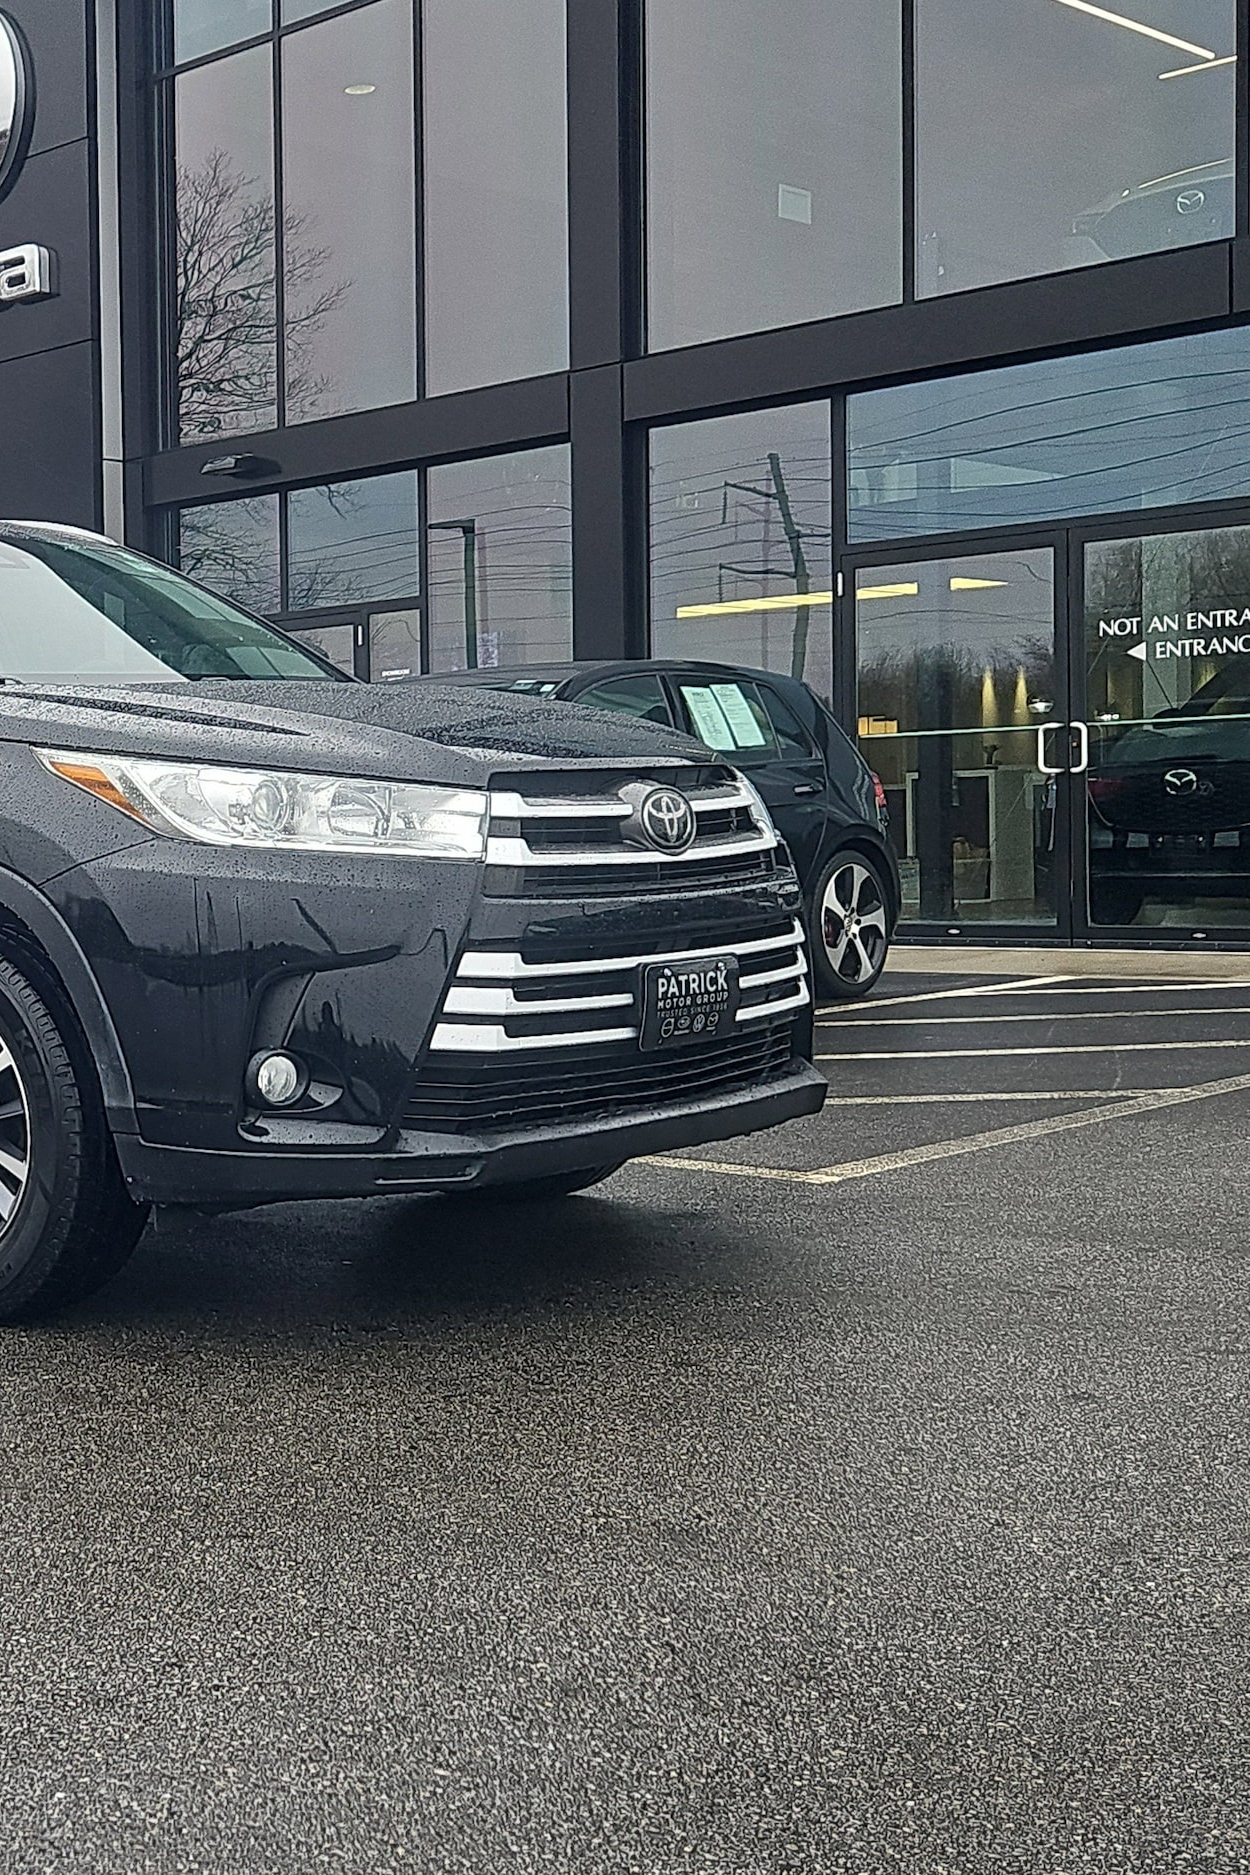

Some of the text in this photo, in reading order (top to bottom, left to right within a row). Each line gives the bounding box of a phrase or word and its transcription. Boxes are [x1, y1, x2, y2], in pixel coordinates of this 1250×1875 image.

[1099, 617, 1141, 637] NOT
[1147, 613, 1179, 633] AN
[1155, 634, 1250, 659] ENTRANC
[657, 969, 729, 999] PATRICK
[656, 1007, 689, 1019] TRUSTED
[690, 1004, 710, 1015] SINCE
[657, 991, 729, 1010] MOTOR GROUP
